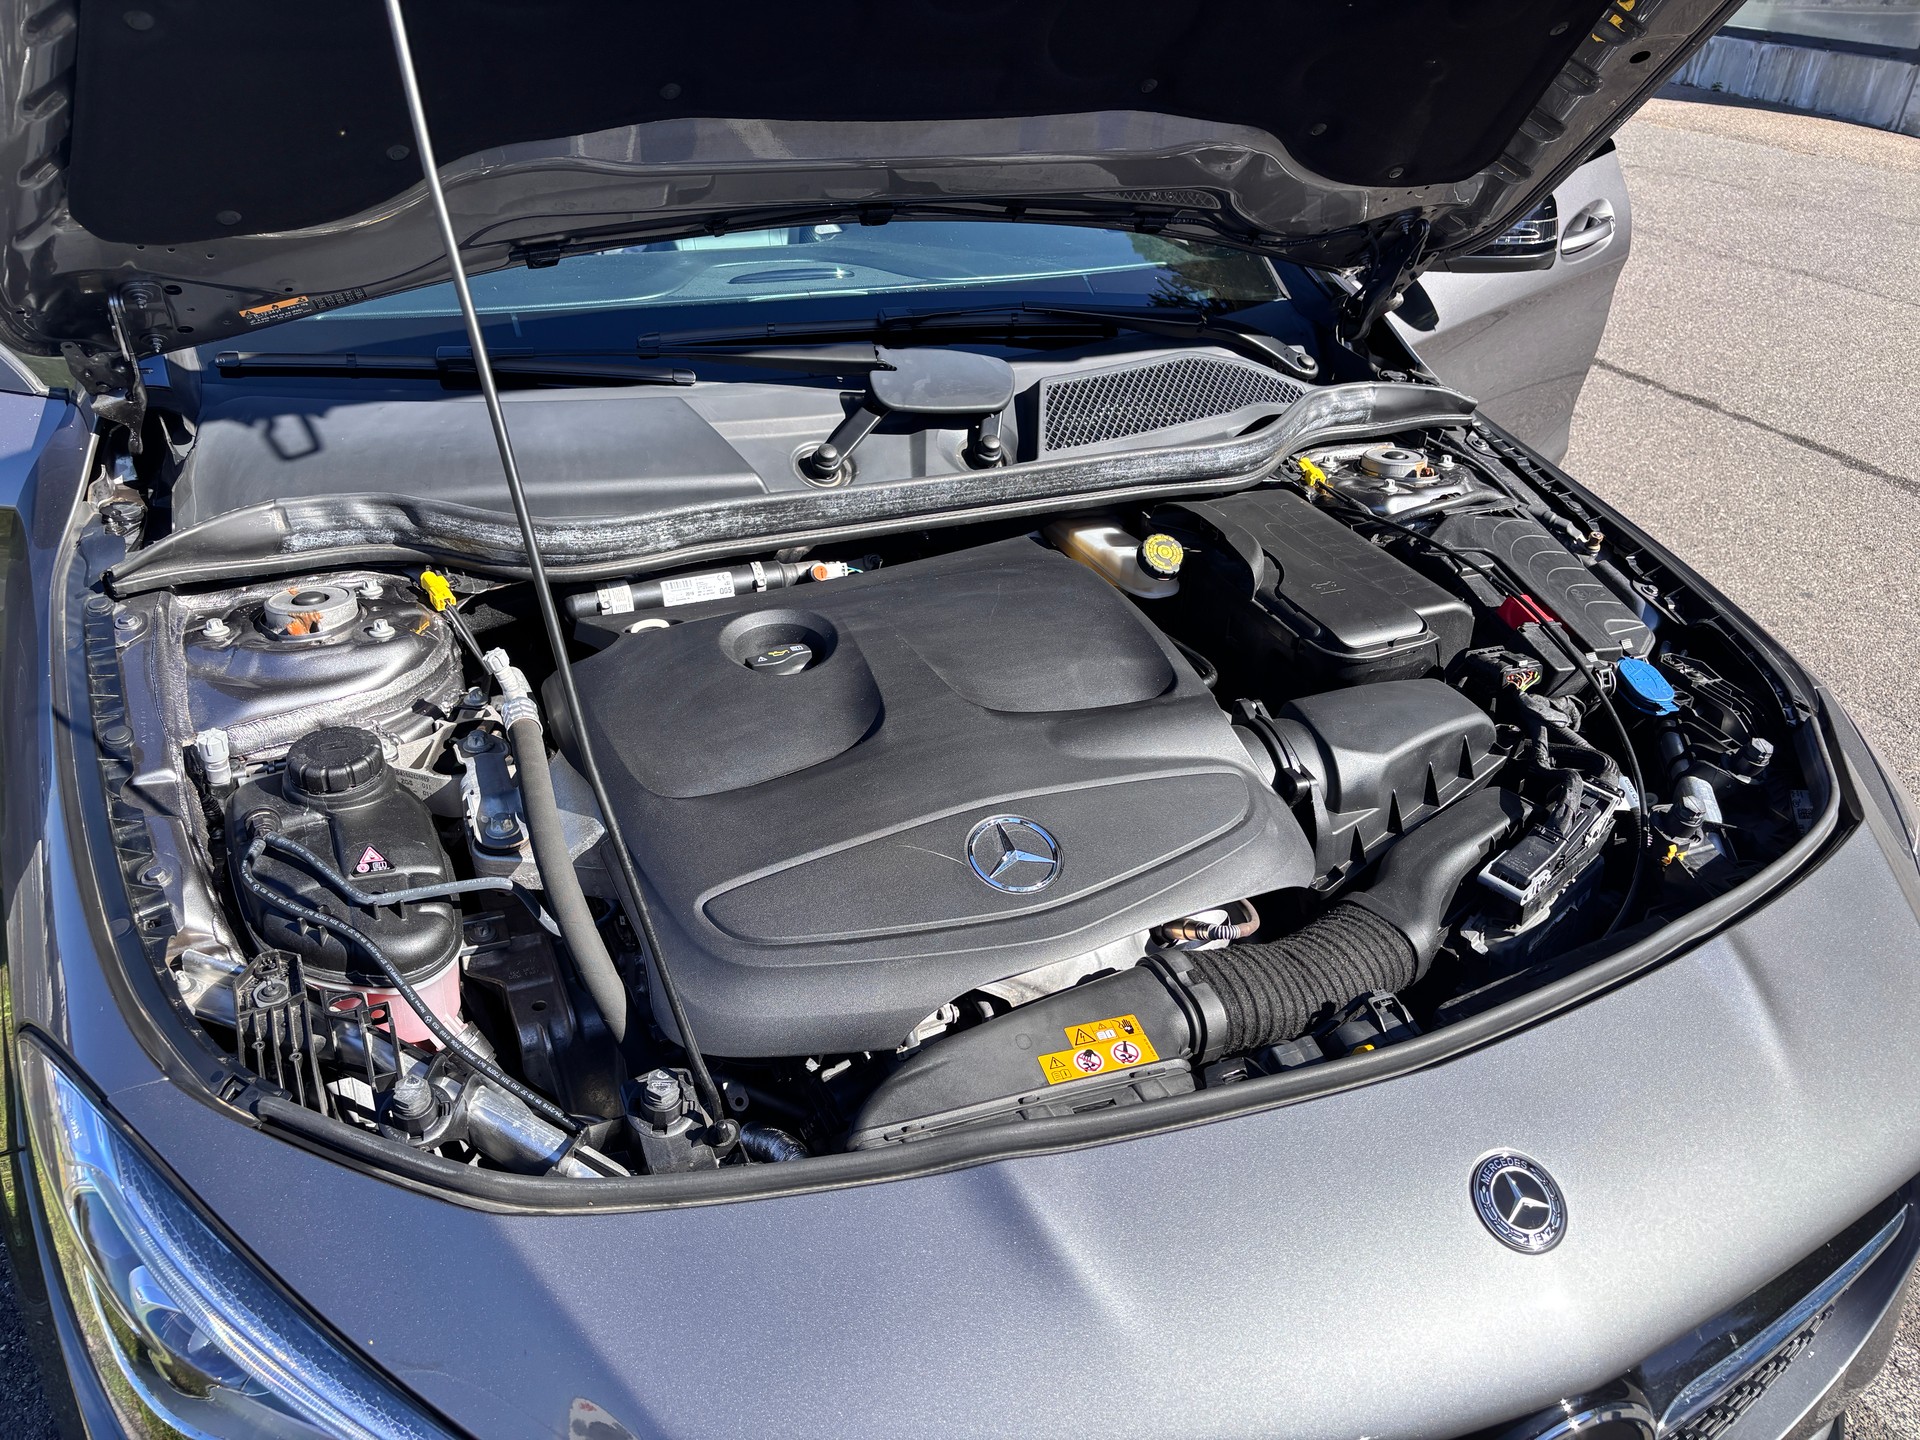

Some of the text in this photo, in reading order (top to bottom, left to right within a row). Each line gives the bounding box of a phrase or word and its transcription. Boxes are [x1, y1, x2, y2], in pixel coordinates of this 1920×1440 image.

[400, 983, 417, 1001] Poland
[1480, 1157, 1528, 1185] MERCEDES
[1529, 1226, 1555, 1245] ENZ
